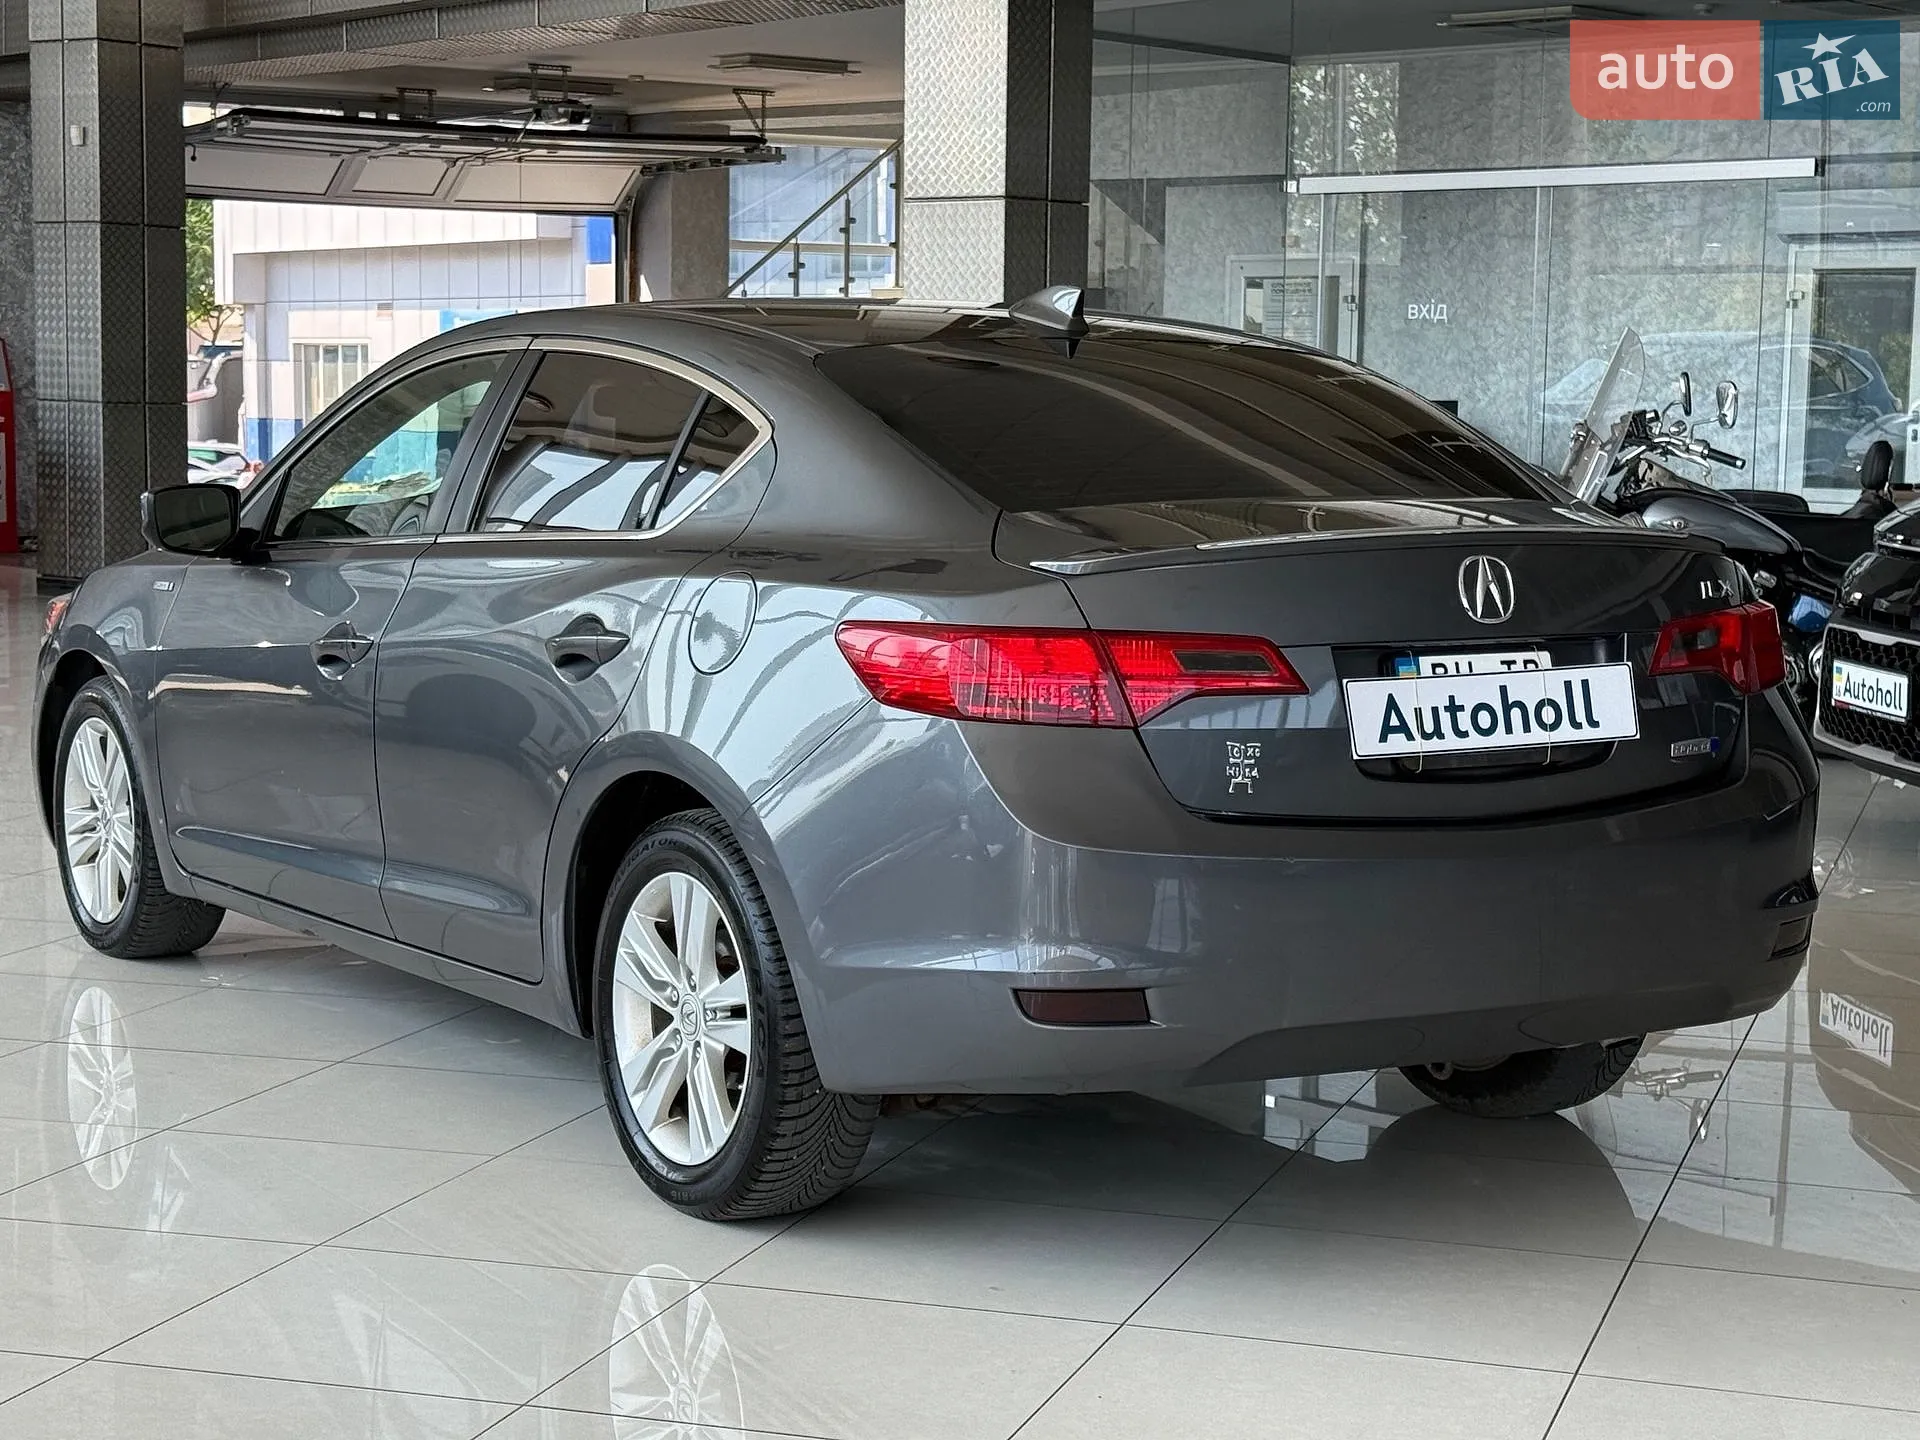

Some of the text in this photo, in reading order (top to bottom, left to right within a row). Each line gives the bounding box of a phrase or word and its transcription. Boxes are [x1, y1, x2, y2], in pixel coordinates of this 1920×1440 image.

[1408, 298, 1448, 324] вхід
[1378, 678, 1601, 744] Autoholl
[1843, 671, 1903, 711] Autoholl
